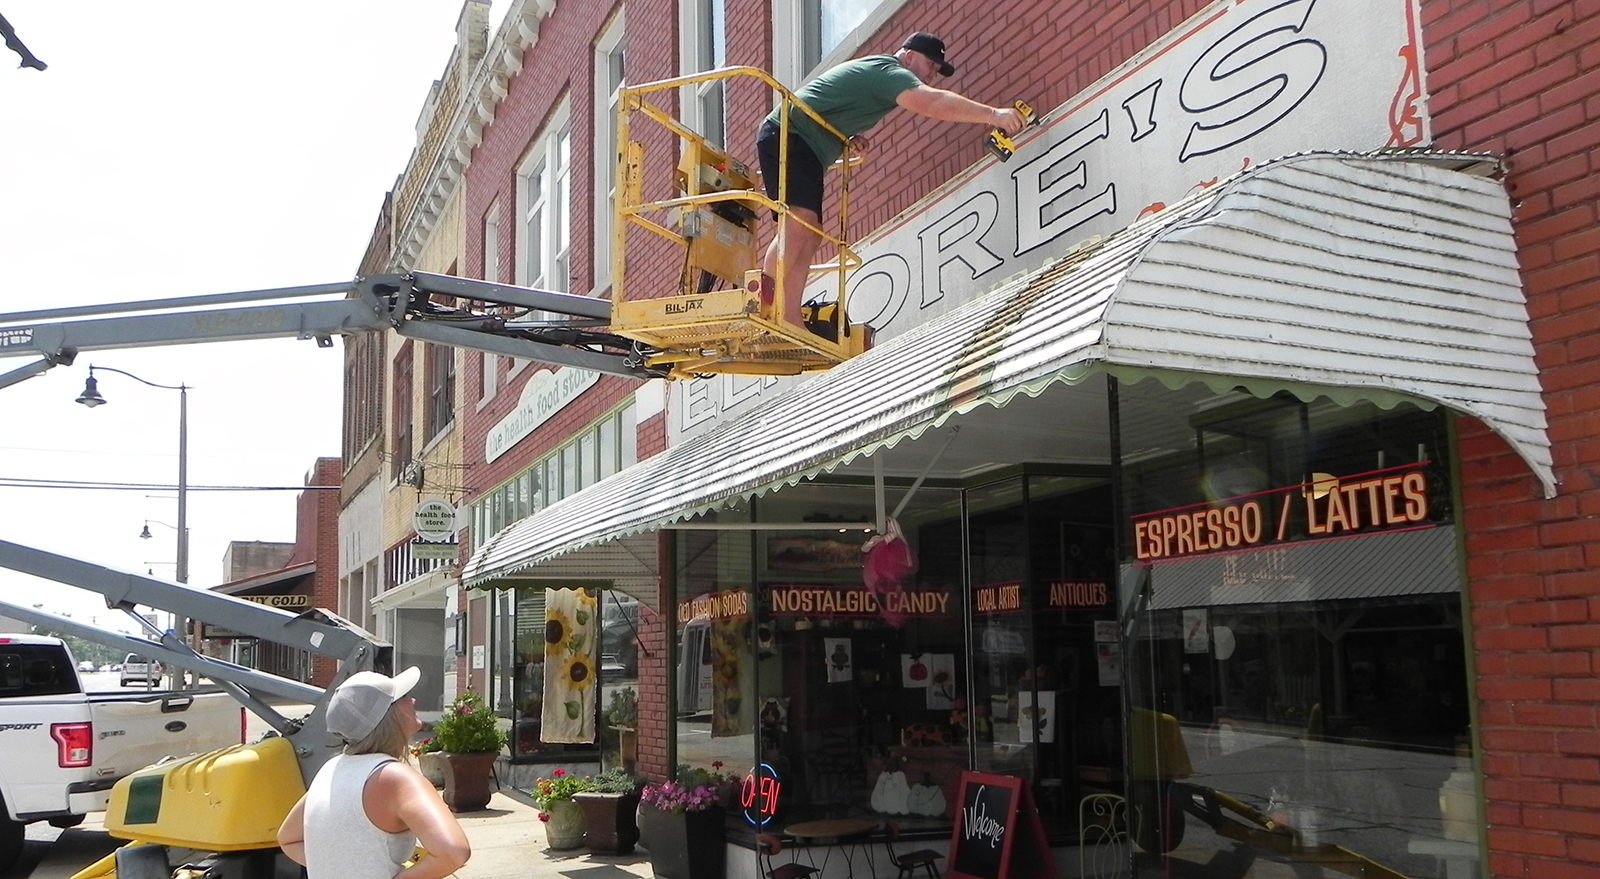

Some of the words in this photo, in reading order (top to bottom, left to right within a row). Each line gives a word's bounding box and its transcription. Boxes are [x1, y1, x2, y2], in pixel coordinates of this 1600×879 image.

[680, 0, 1327, 433] ELORE'S
[665, 298, 705, 314] BIL-JAX
[504, 404, 535, 445] health
[536, 380, 560, 419] food
[1134, 501, 1262, 559] ESPRESSO
[1305, 471, 1428, 535] LATTES
[271, 596, 307, 606] GOLD
[692, 597, 720, 620] FASHION
[723, 592, 748, 617] SODAS
[771, 589, 877, 613] NOSTALGIC
[886, 591, 950, 614] CANDY
[976, 588, 997, 612] LOCAL
[998, 584, 1020, 610] ARTIST
[1049, 582, 1107, 607] ANTIQUES
[963, 784, 1005, 849] Welcome
